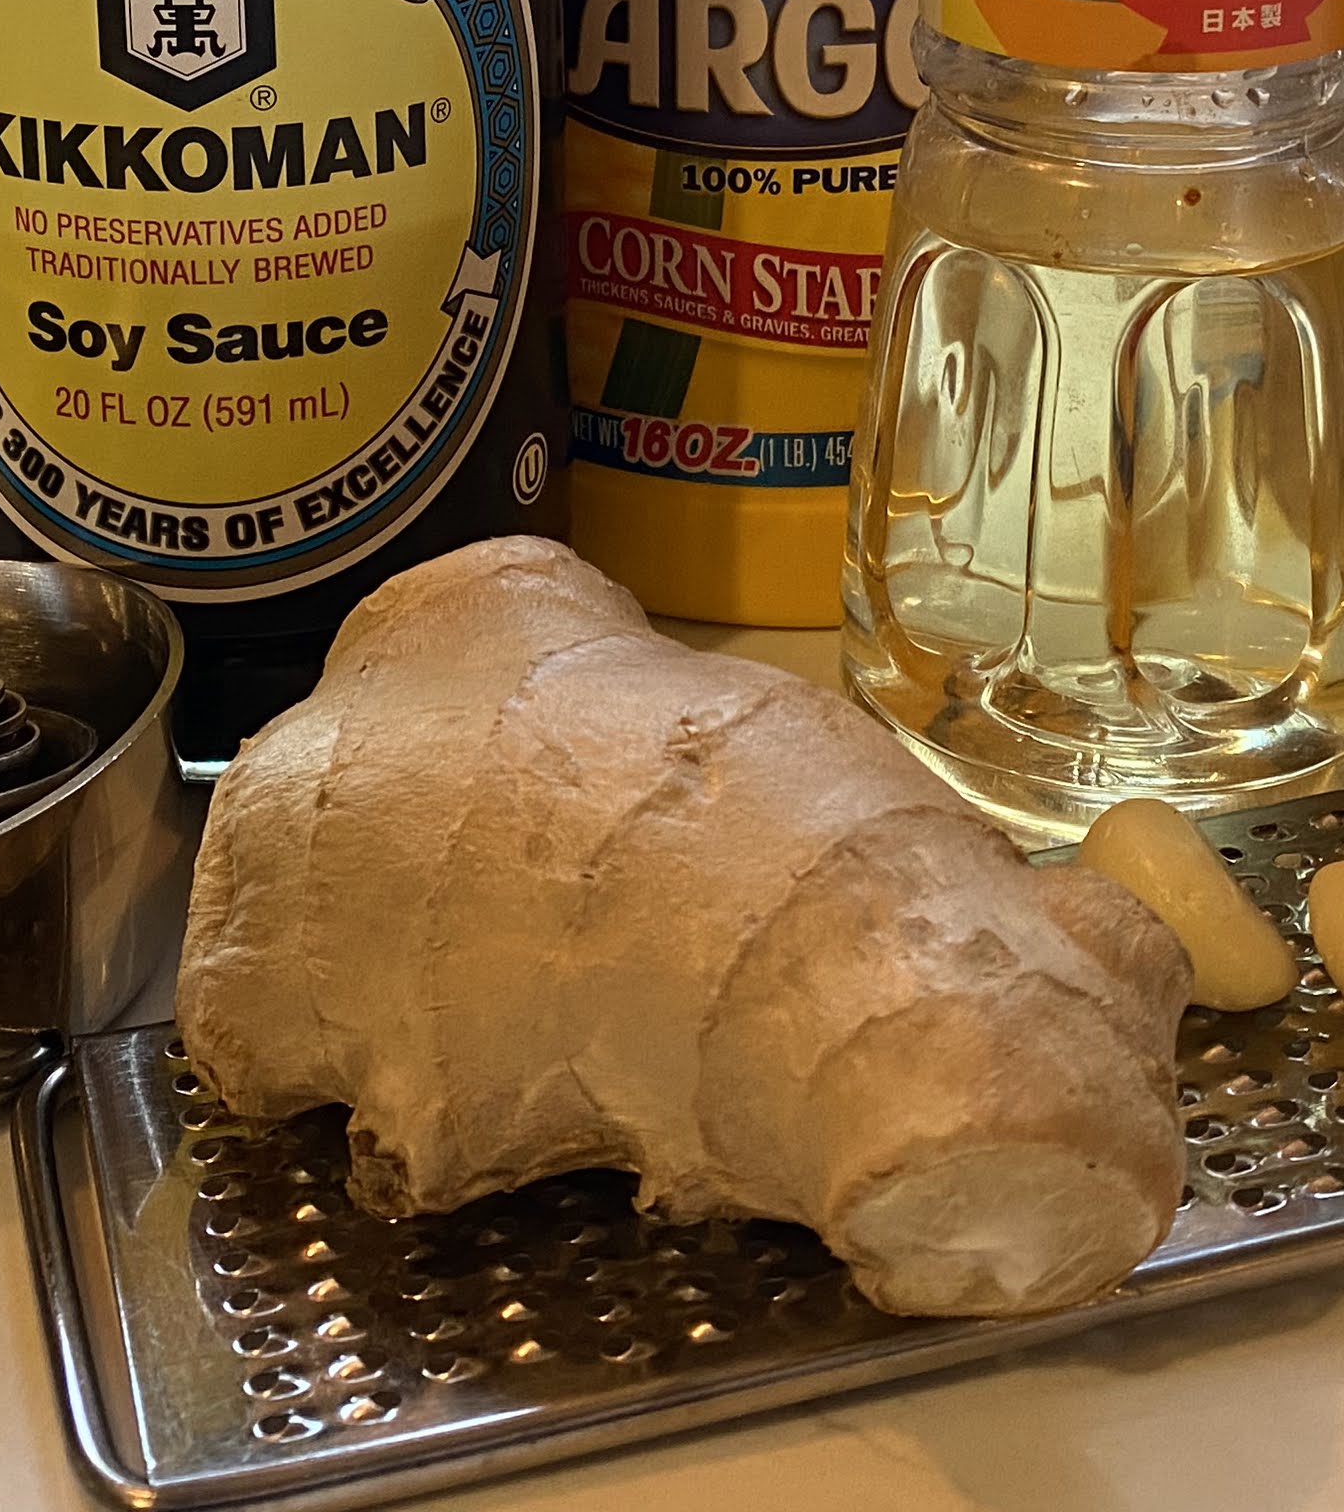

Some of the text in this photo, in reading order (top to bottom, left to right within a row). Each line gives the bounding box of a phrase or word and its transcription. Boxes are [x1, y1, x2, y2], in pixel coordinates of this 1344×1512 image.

[1202, 1, 1283, 34] 日本製
[682, 163, 900, 196] 100% PURE
[14, 202, 387, 246] NO PRESERVATIVES ADDED
[25, 244, 374, 286] TRADITIONALLY BREWED
[578, 216, 736, 305] CORN
[579, 277, 649, 305] THICKENS
[653, 293, 717, 322] SAUCES
[722, 309, 735, 325] &
[27, 300, 388, 372] Soy Sauce
[55, 382, 350, 432] 20 FL OZ (591 mL)
[2, 427, 65, 499] 300
[74, 479, 210, 553] YEARS
[224, 505, 285, 550] OF
[293, 309, 490, 533] EXCELLENCE
[760, 438, 774, 472] (1
[783, 438, 817, 472] LB.)
